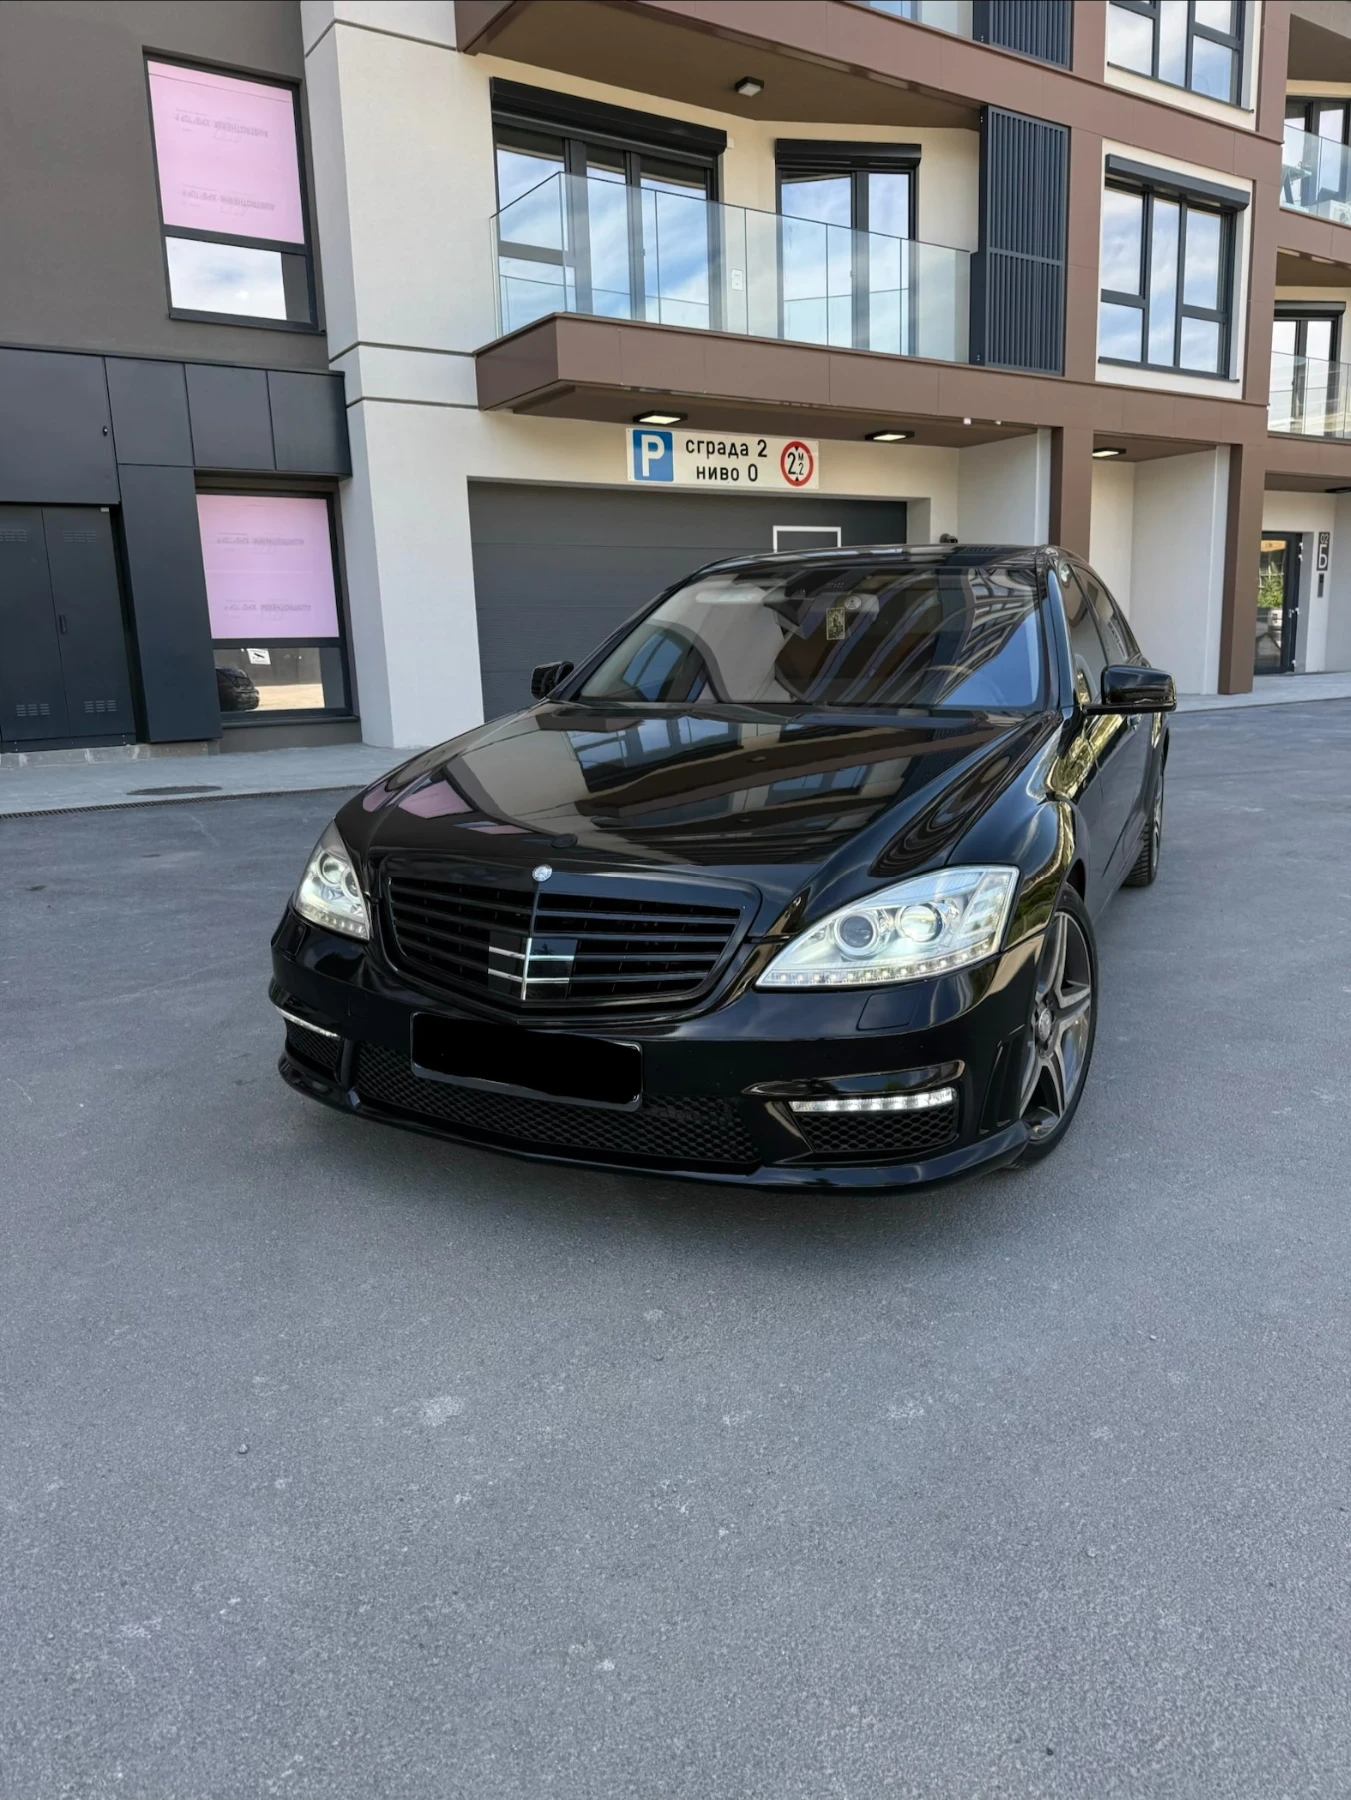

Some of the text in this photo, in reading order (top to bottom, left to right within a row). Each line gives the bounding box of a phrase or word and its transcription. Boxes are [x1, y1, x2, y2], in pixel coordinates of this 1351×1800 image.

[641, 434, 665, 477] P
[685, 438, 768, 459] сграда 2
[696, 465, 739, 481] ниво
[1320, 533, 1328, 543] 02
[1318, 543, 1328, 569] Б
